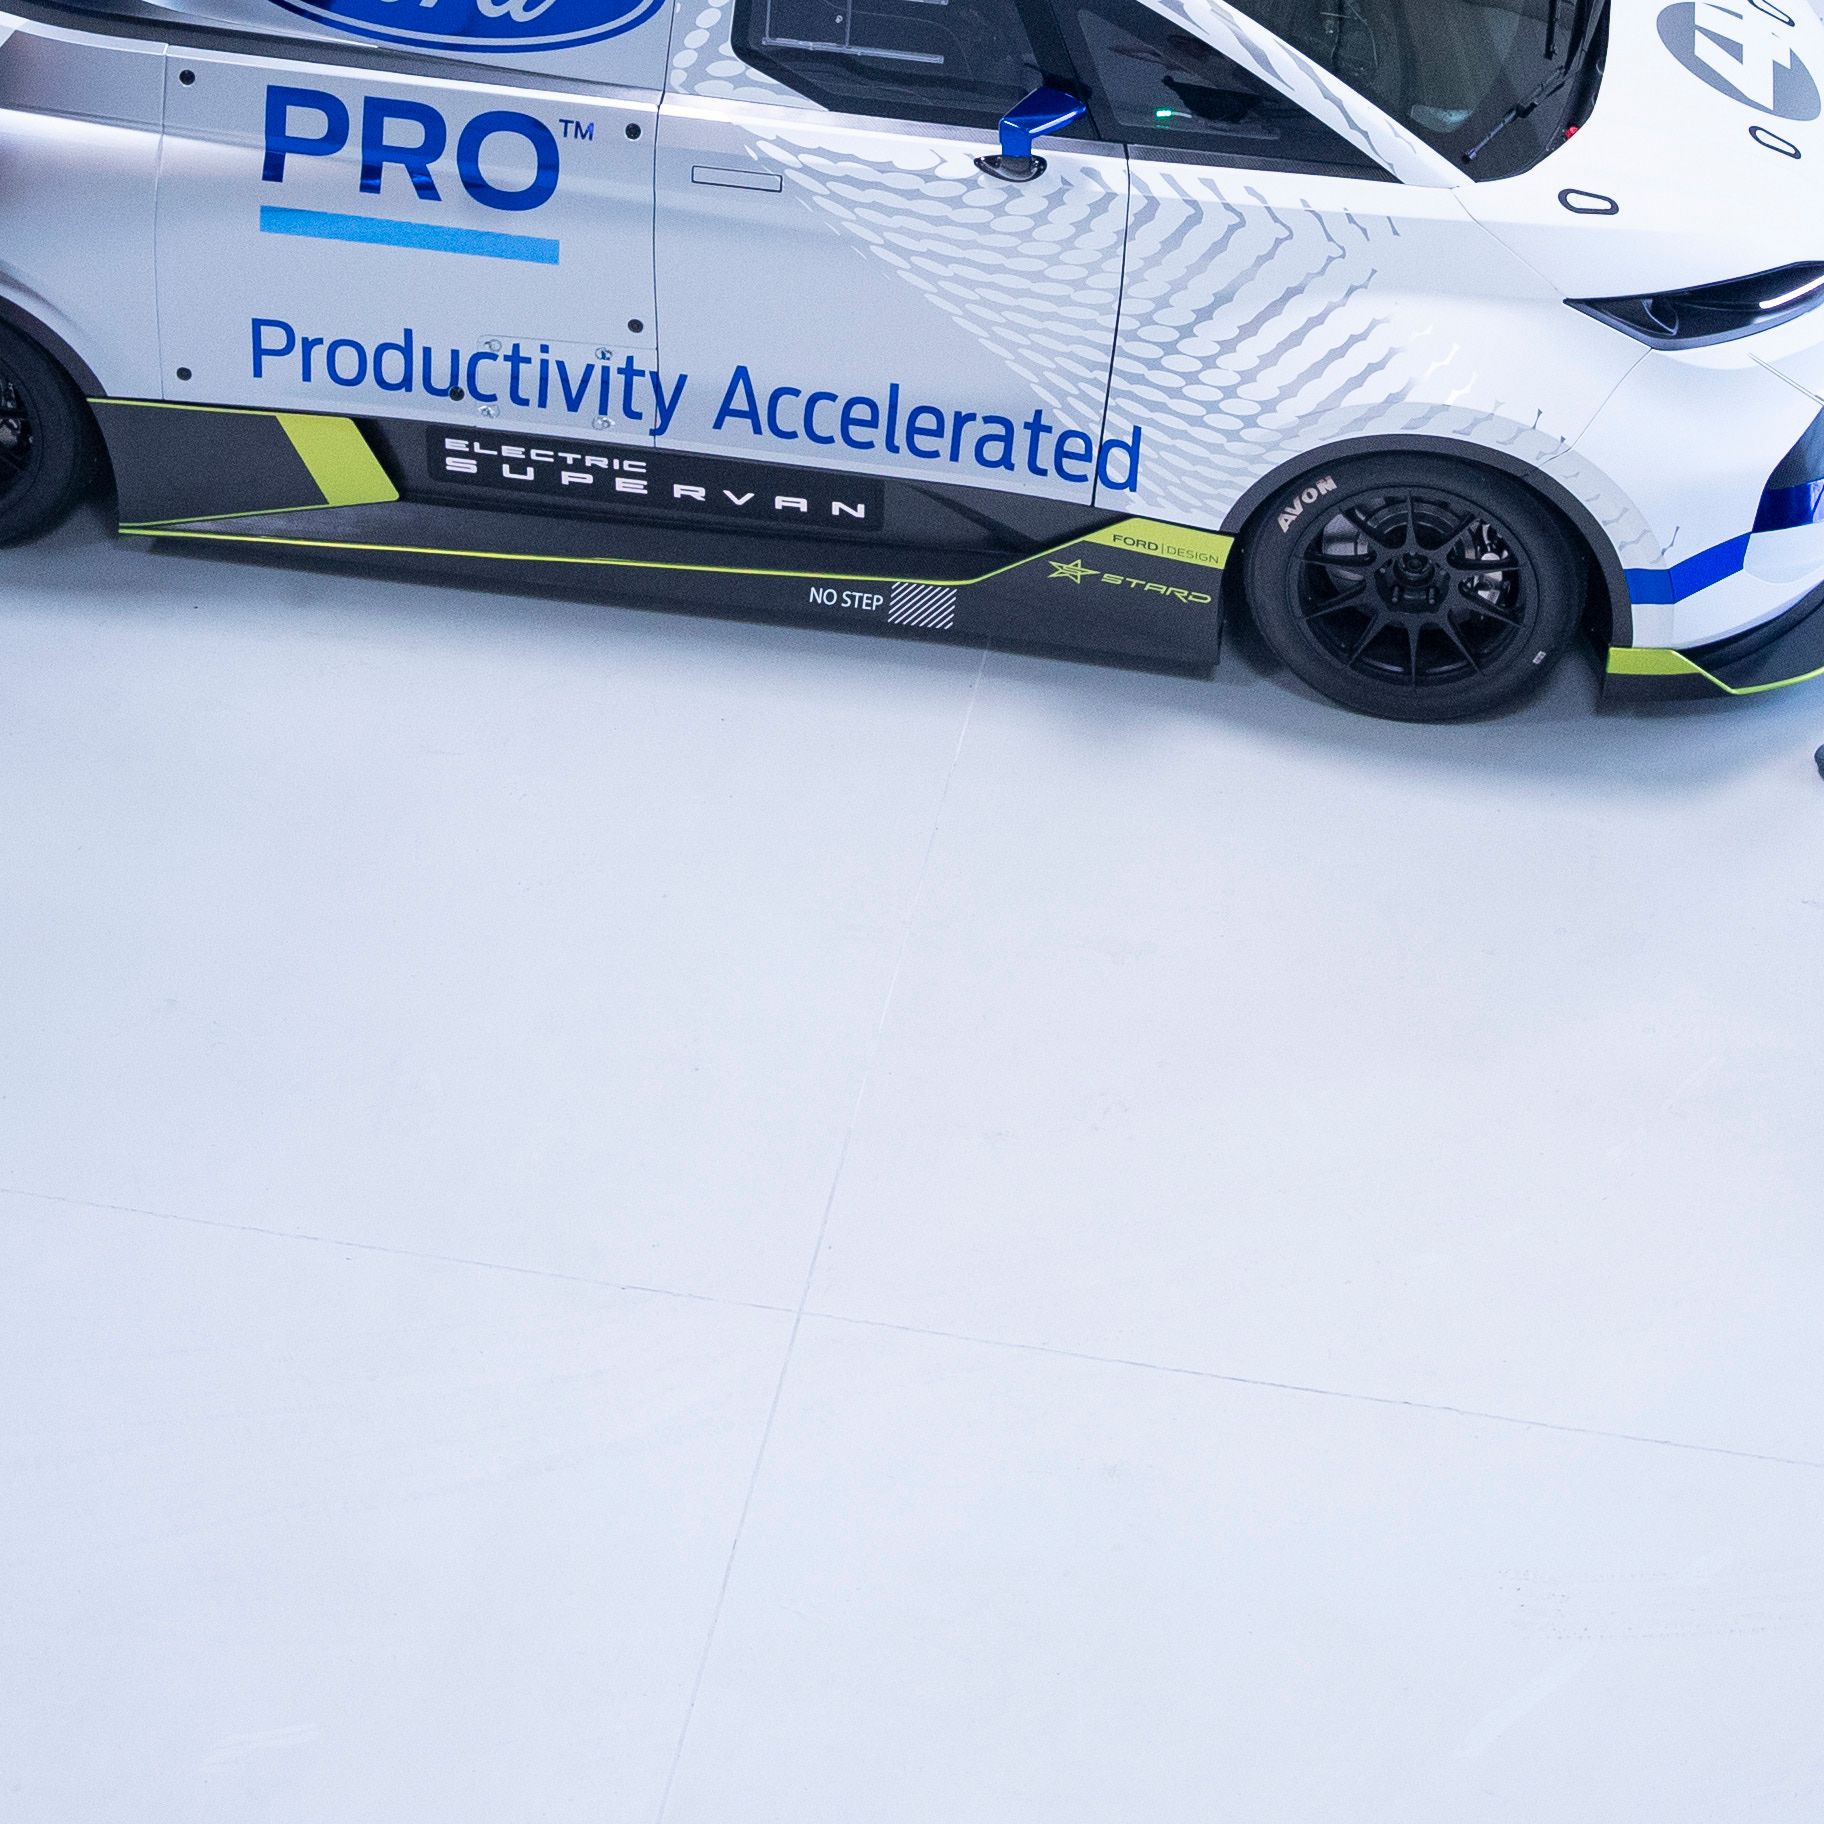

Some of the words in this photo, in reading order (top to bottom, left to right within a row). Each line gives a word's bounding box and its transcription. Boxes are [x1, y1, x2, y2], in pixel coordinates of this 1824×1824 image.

[251, 317, 688, 436] Productivity
[712, 364, 1142, 493] Accelerated
[444, 437, 647, 473] ELECTRIC
[445, 456, 865, 519] SUPERVAN
[1277, 475, 1337, 534] AVON
[1112, 534, 1159, 552] FORD
[809, 586, 838, 608] NO
[841, 591, 884, 612] STEP
[1101, 572, 1212, 604] STARD
